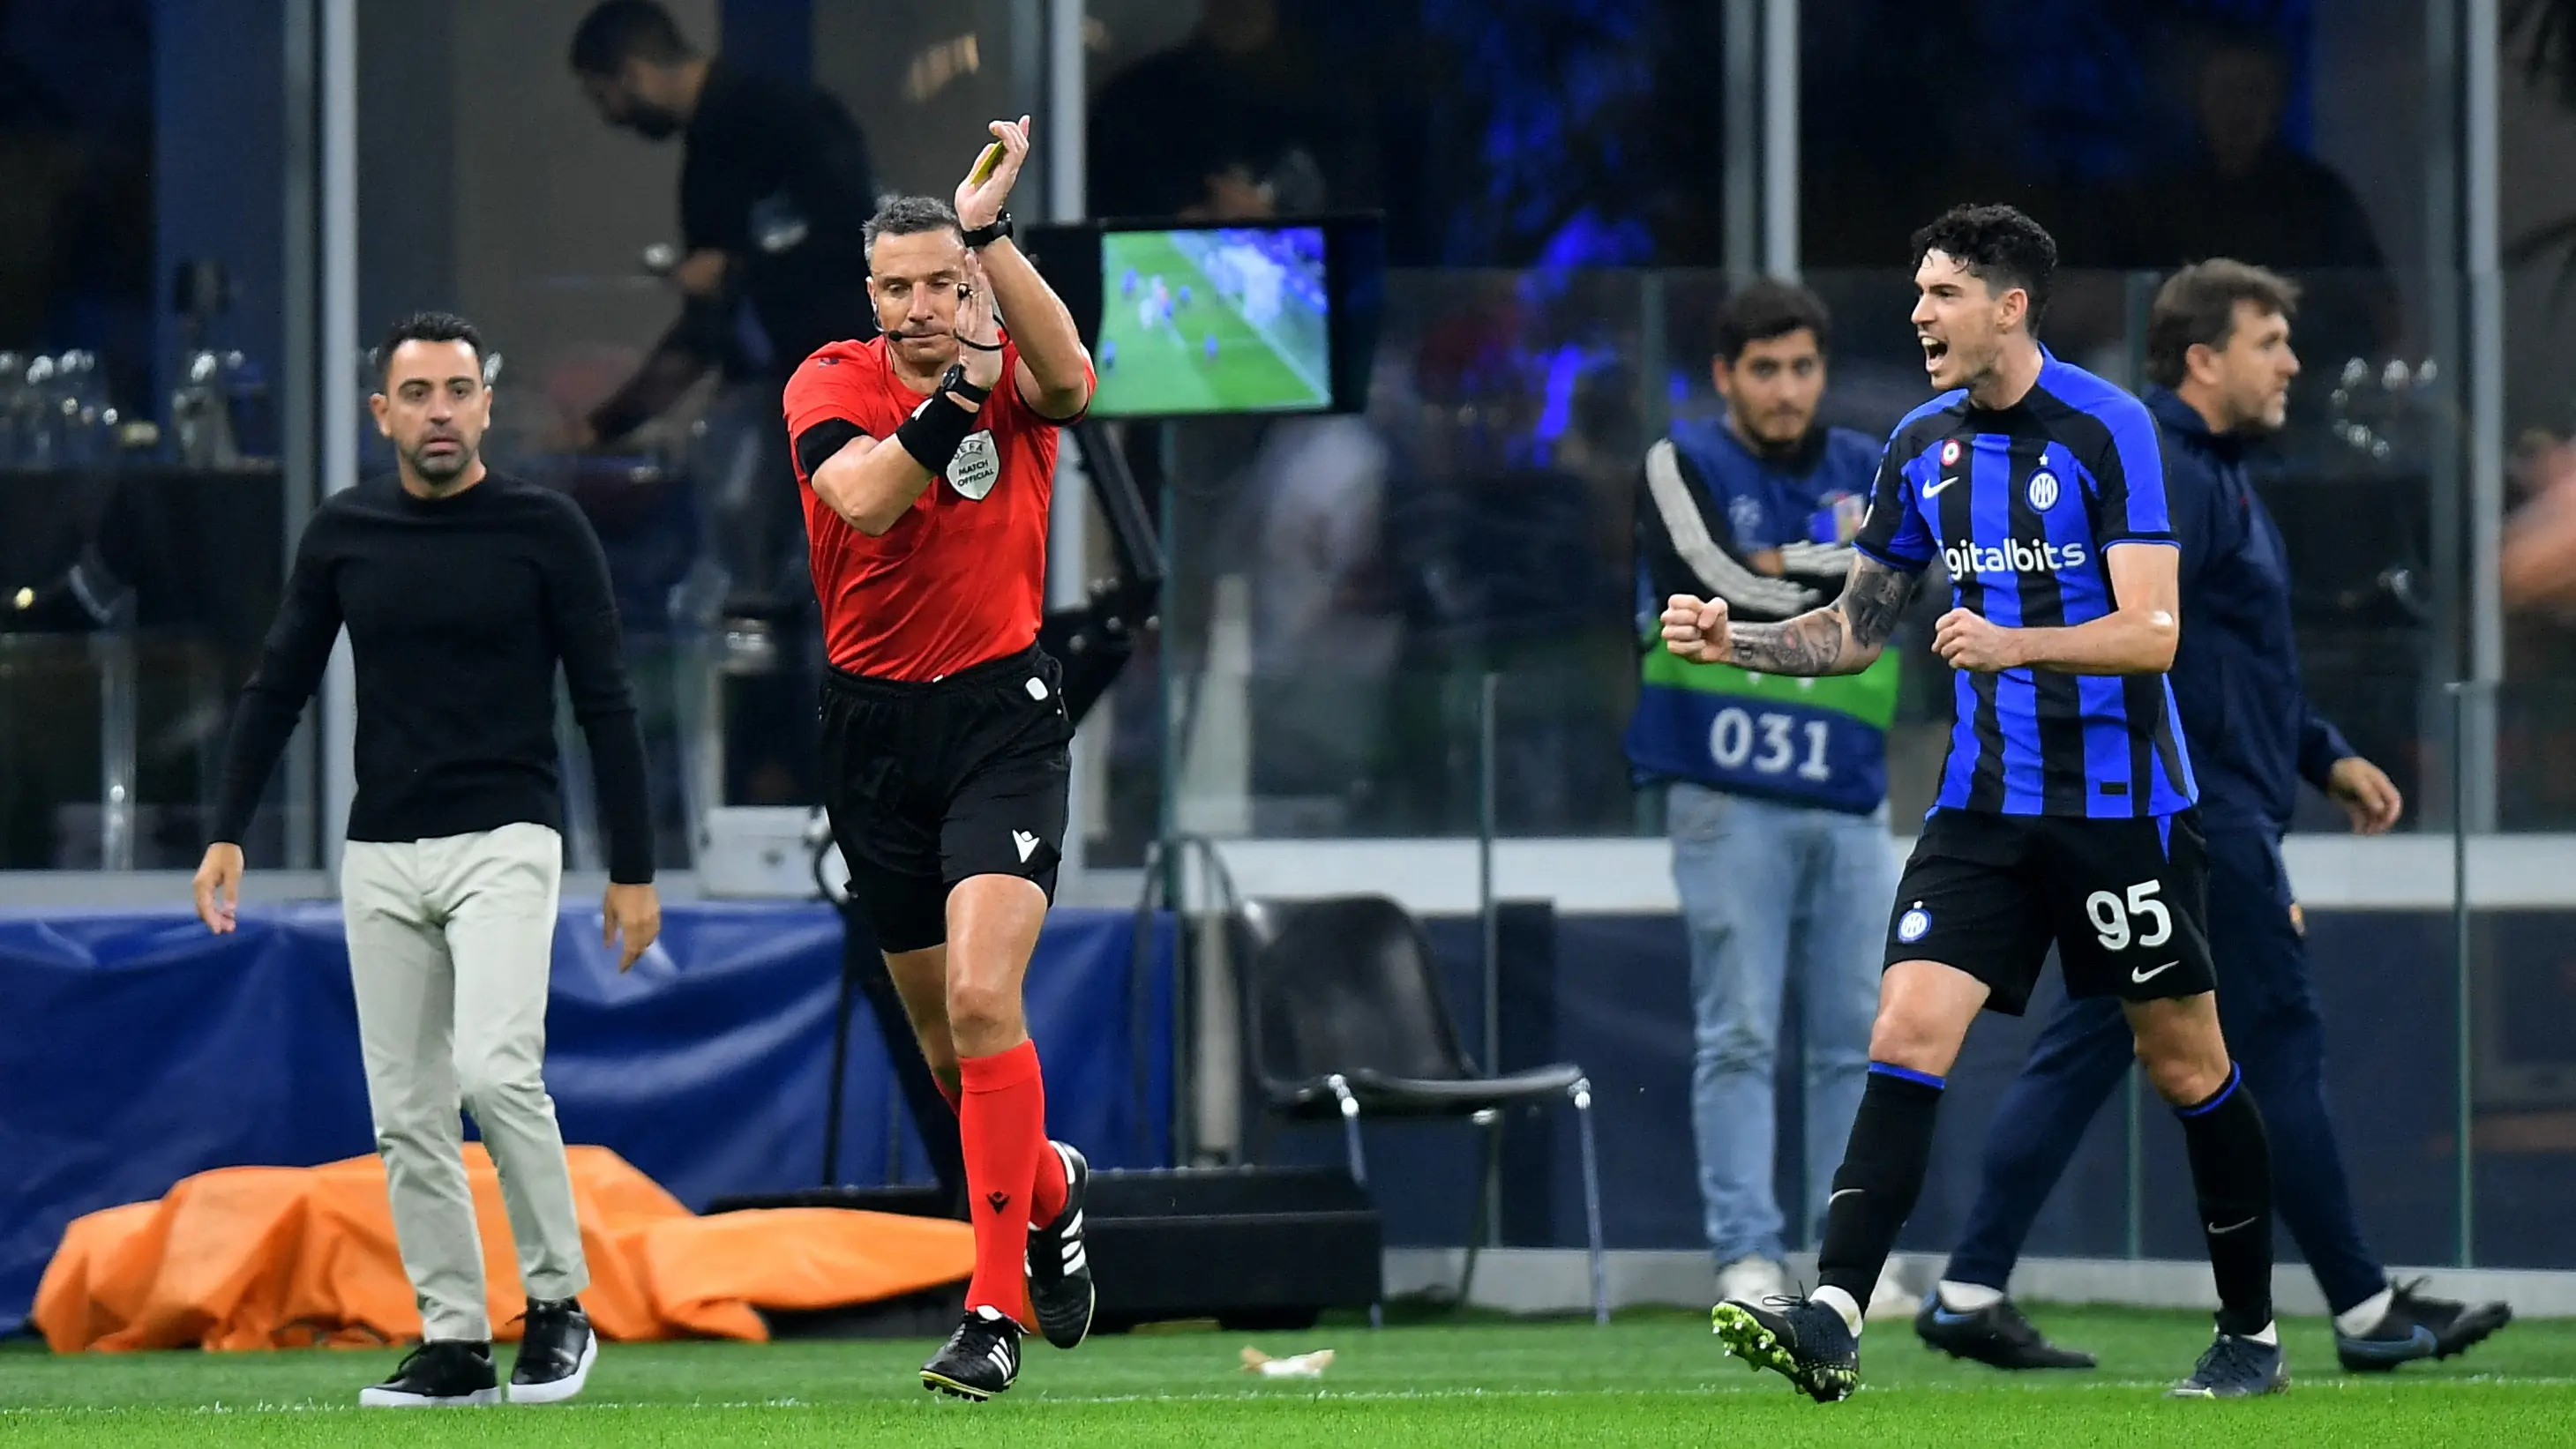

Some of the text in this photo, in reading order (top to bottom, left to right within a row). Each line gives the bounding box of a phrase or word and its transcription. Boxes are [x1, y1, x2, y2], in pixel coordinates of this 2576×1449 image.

[957, 467, 995, 487] OFFICIAL
[958, 459, 989, 476] MATCH
[1709, 707, 1831, 781] 031
[2086, 878, 2172, 951] 95
